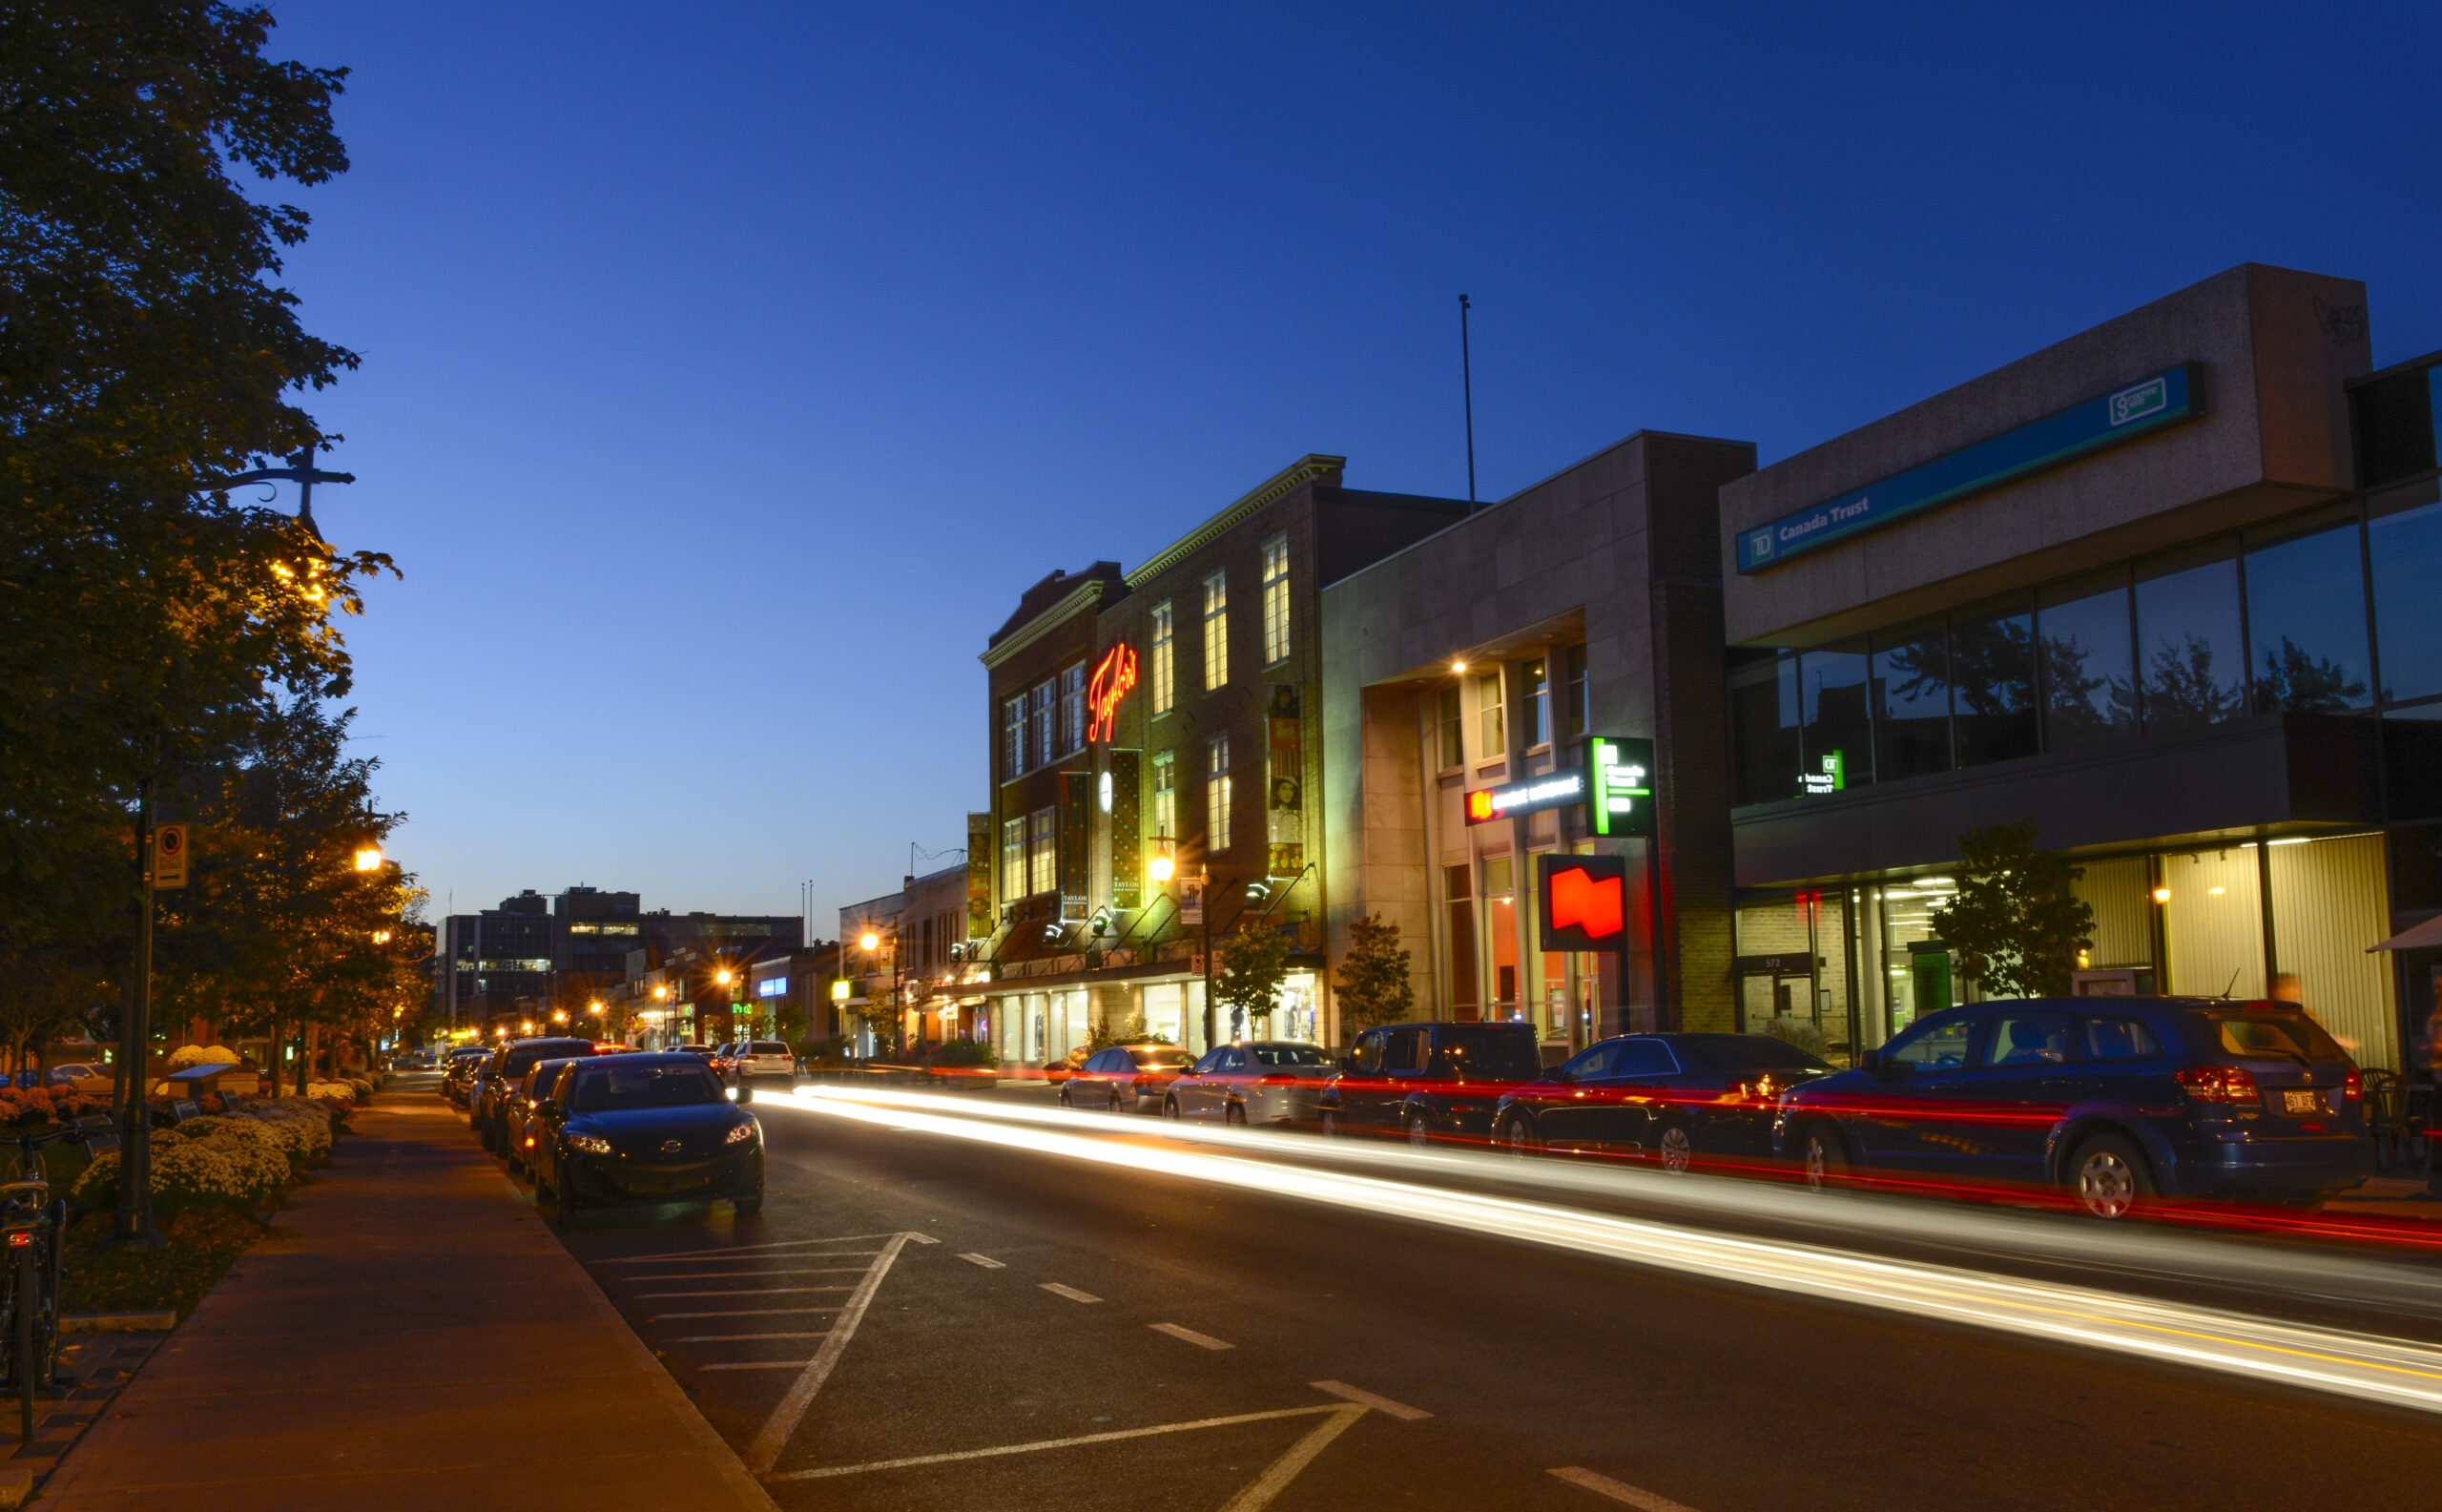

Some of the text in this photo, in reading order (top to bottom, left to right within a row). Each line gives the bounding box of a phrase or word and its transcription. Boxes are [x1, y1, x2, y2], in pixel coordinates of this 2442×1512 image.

[1752, 496, 1870, 557] TD Canada Trust
[1766, 958, 1782, 968] 572
